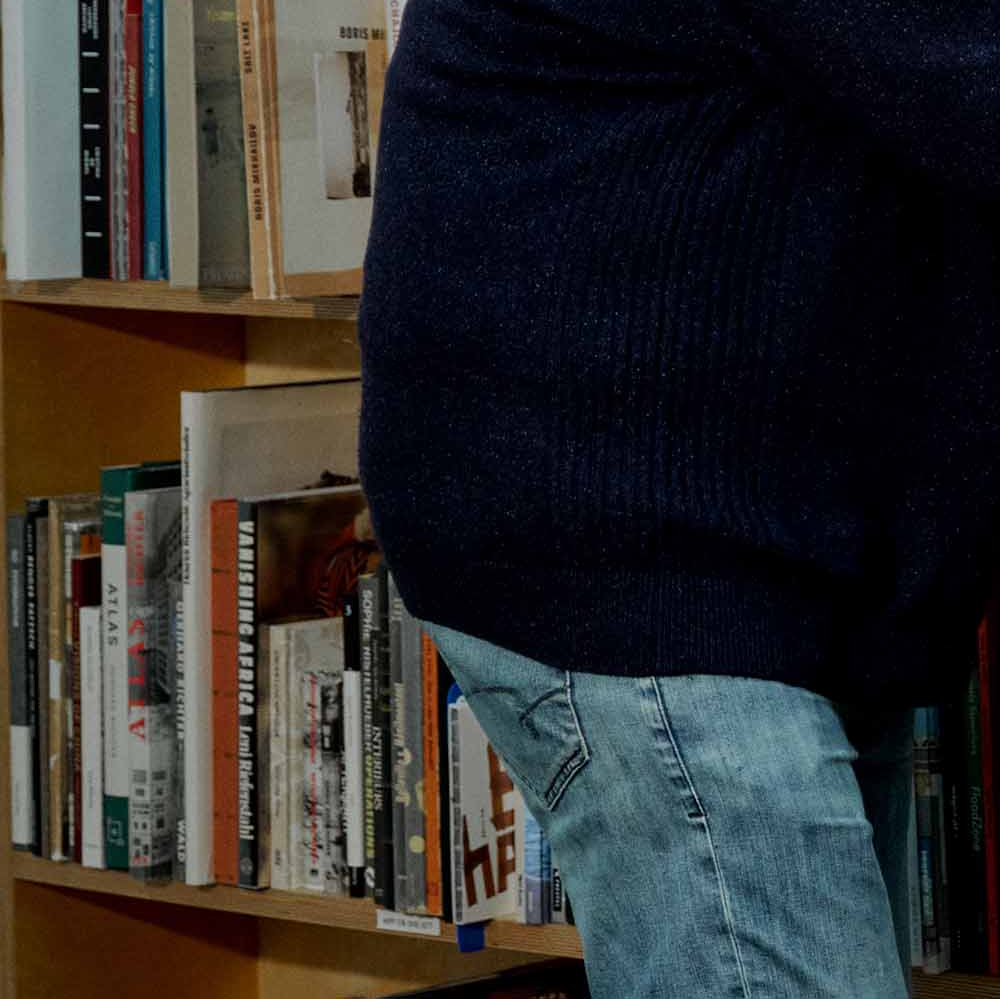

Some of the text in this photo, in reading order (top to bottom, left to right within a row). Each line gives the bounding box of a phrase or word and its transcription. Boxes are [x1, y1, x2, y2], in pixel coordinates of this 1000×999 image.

[339, 26, 369, 40] BORIS
[252, 188, 263, 222] BORIS
[107, 583, 120, 647] ATLAS
[127, 617, 146, 742] ATLAS
[238, 520, 255, 840] VANISHING AFRICA Leni Riefenstahl
[361, 589, 375, 860] SOPHIE RISTELHUEBER OPERATIONS
[372, 726, 385, 811] INTERIEURS
[176, 818, 186, 864] WALD
